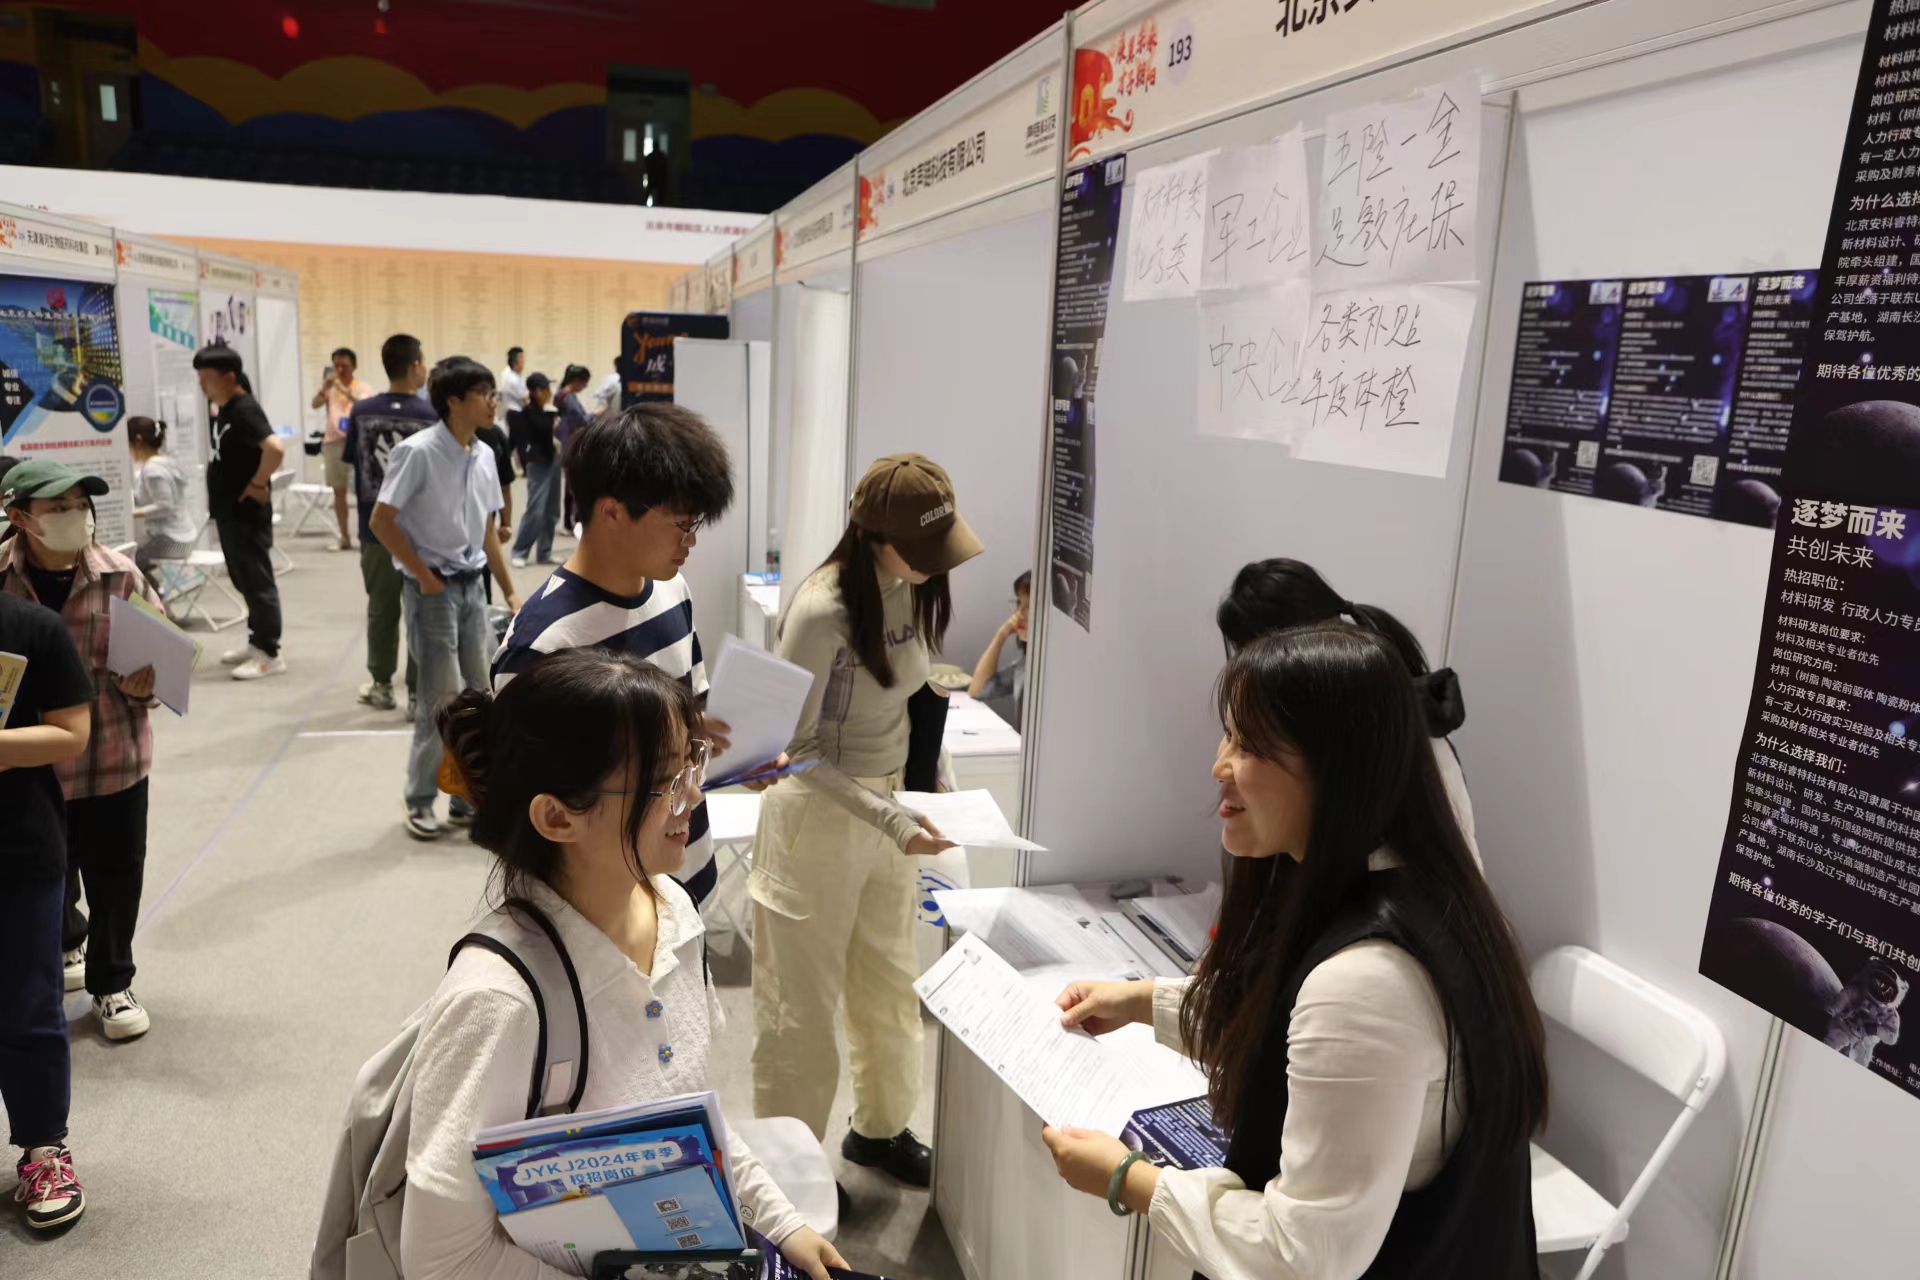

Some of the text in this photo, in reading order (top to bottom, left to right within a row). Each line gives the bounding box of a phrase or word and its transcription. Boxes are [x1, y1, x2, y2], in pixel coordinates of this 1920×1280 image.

[1883, 19, 1920, 41] 材料
[1168, 35, 1192, 67] 193
[1845, 214, 1920, 232] 北京安科睿特
[1834, 272, 1920, 287] 丰厚薪资福利待
[1791, 498, 1906, 540] 逐梦而来
[1787, 534, 1874, 569] 共创未来
[1783, 567, 1846, 592] 热招职位：
[1780, 589, 1835, 614] 材料研发
[883, 623, 915, 648] ILA
[1775, 630, 1880, 667] 材料及相关专业者优先
[1760, 710, 1881, 760] 采购及财务相关专业者优先
[1764, 695, 1920, 756] 有一定人力行政实习经验及相关专
[1745, 782, 1920, 861] 院牵头组建，国内多所顶级院所提供技
[569, 1166, 637, 1186] 校招岗位
